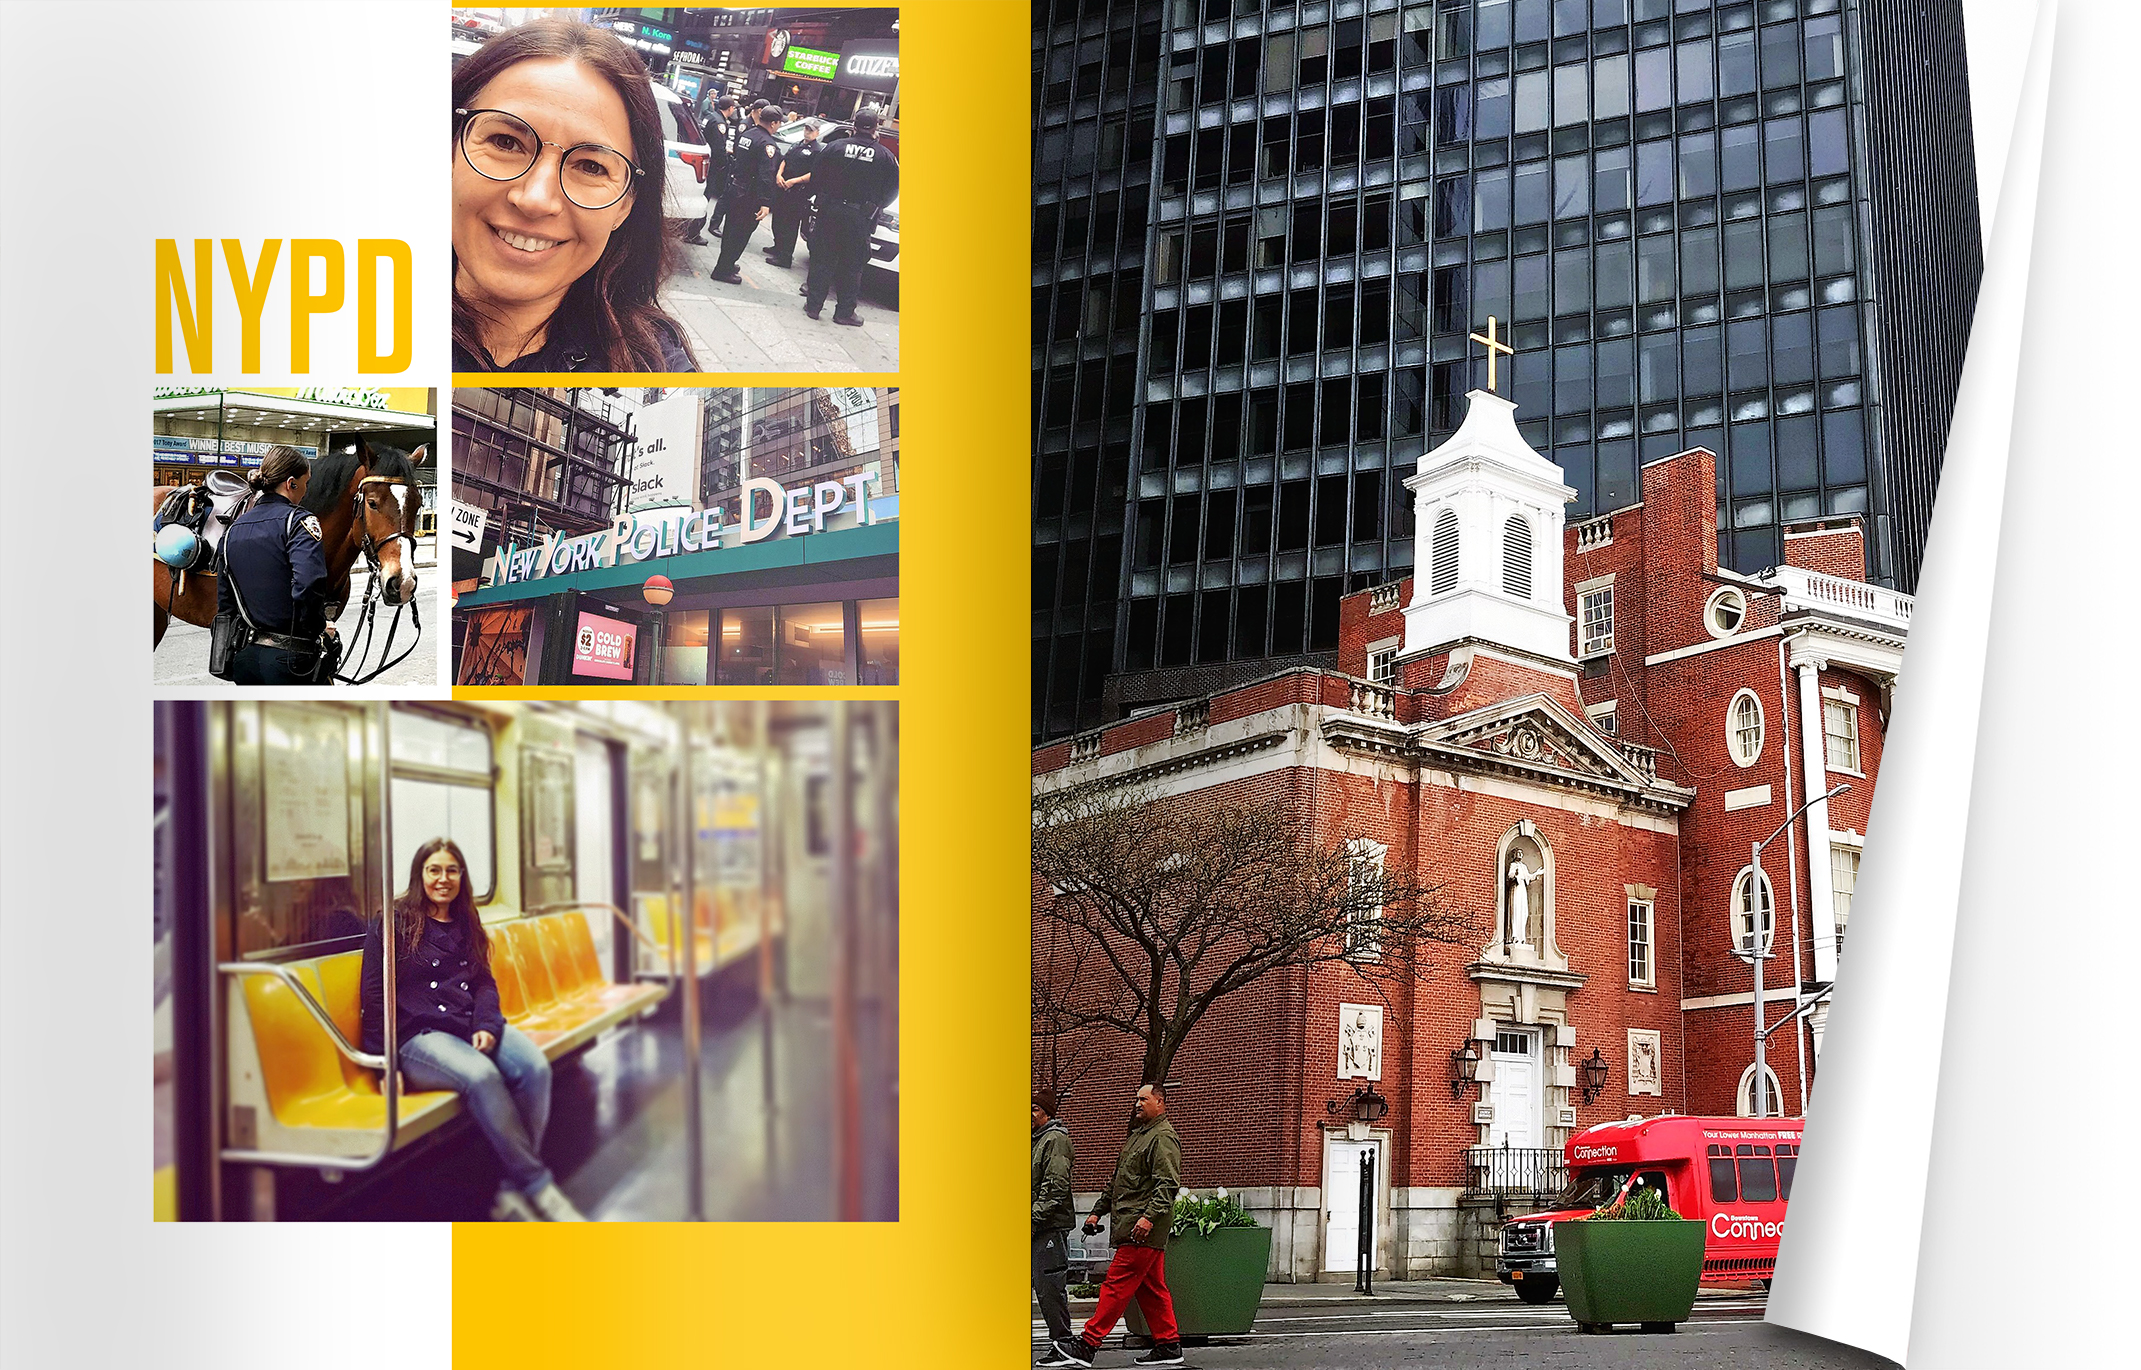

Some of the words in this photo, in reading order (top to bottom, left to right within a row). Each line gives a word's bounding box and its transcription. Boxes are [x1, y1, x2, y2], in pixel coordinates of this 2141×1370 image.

[672, 50, 701, 63] SEPHORA
[795, 60, 831, 74] COFFEE
[224, 441, 247, 454] BEST
[647, 438, 667, 454] all.
[631, 474, 664, 494] slack
[456, 508, 481, 529] ZONE
[490, 542, 541, 587] NEW
[541, 530, 606, 578] YORK
[610, 507, 724, 566] POLICE
[740, 470, 879, 543] DEPT
[580, 633, 592, 647] $2
[596, 631, 622, 647] COLD
[595, 644, 621, 659] BREW
[1702, 1130, 1718, 1139] Your
[1719, 1131, 1739, 1139] Lower
[1740, 1131, 1777, 1140] Manhattan
[1777, 1131, 1796, 1140] FREE
[1574, 1145, 1617, 1160] Connection
[1711, 1212, 1785, 1241] Connec
